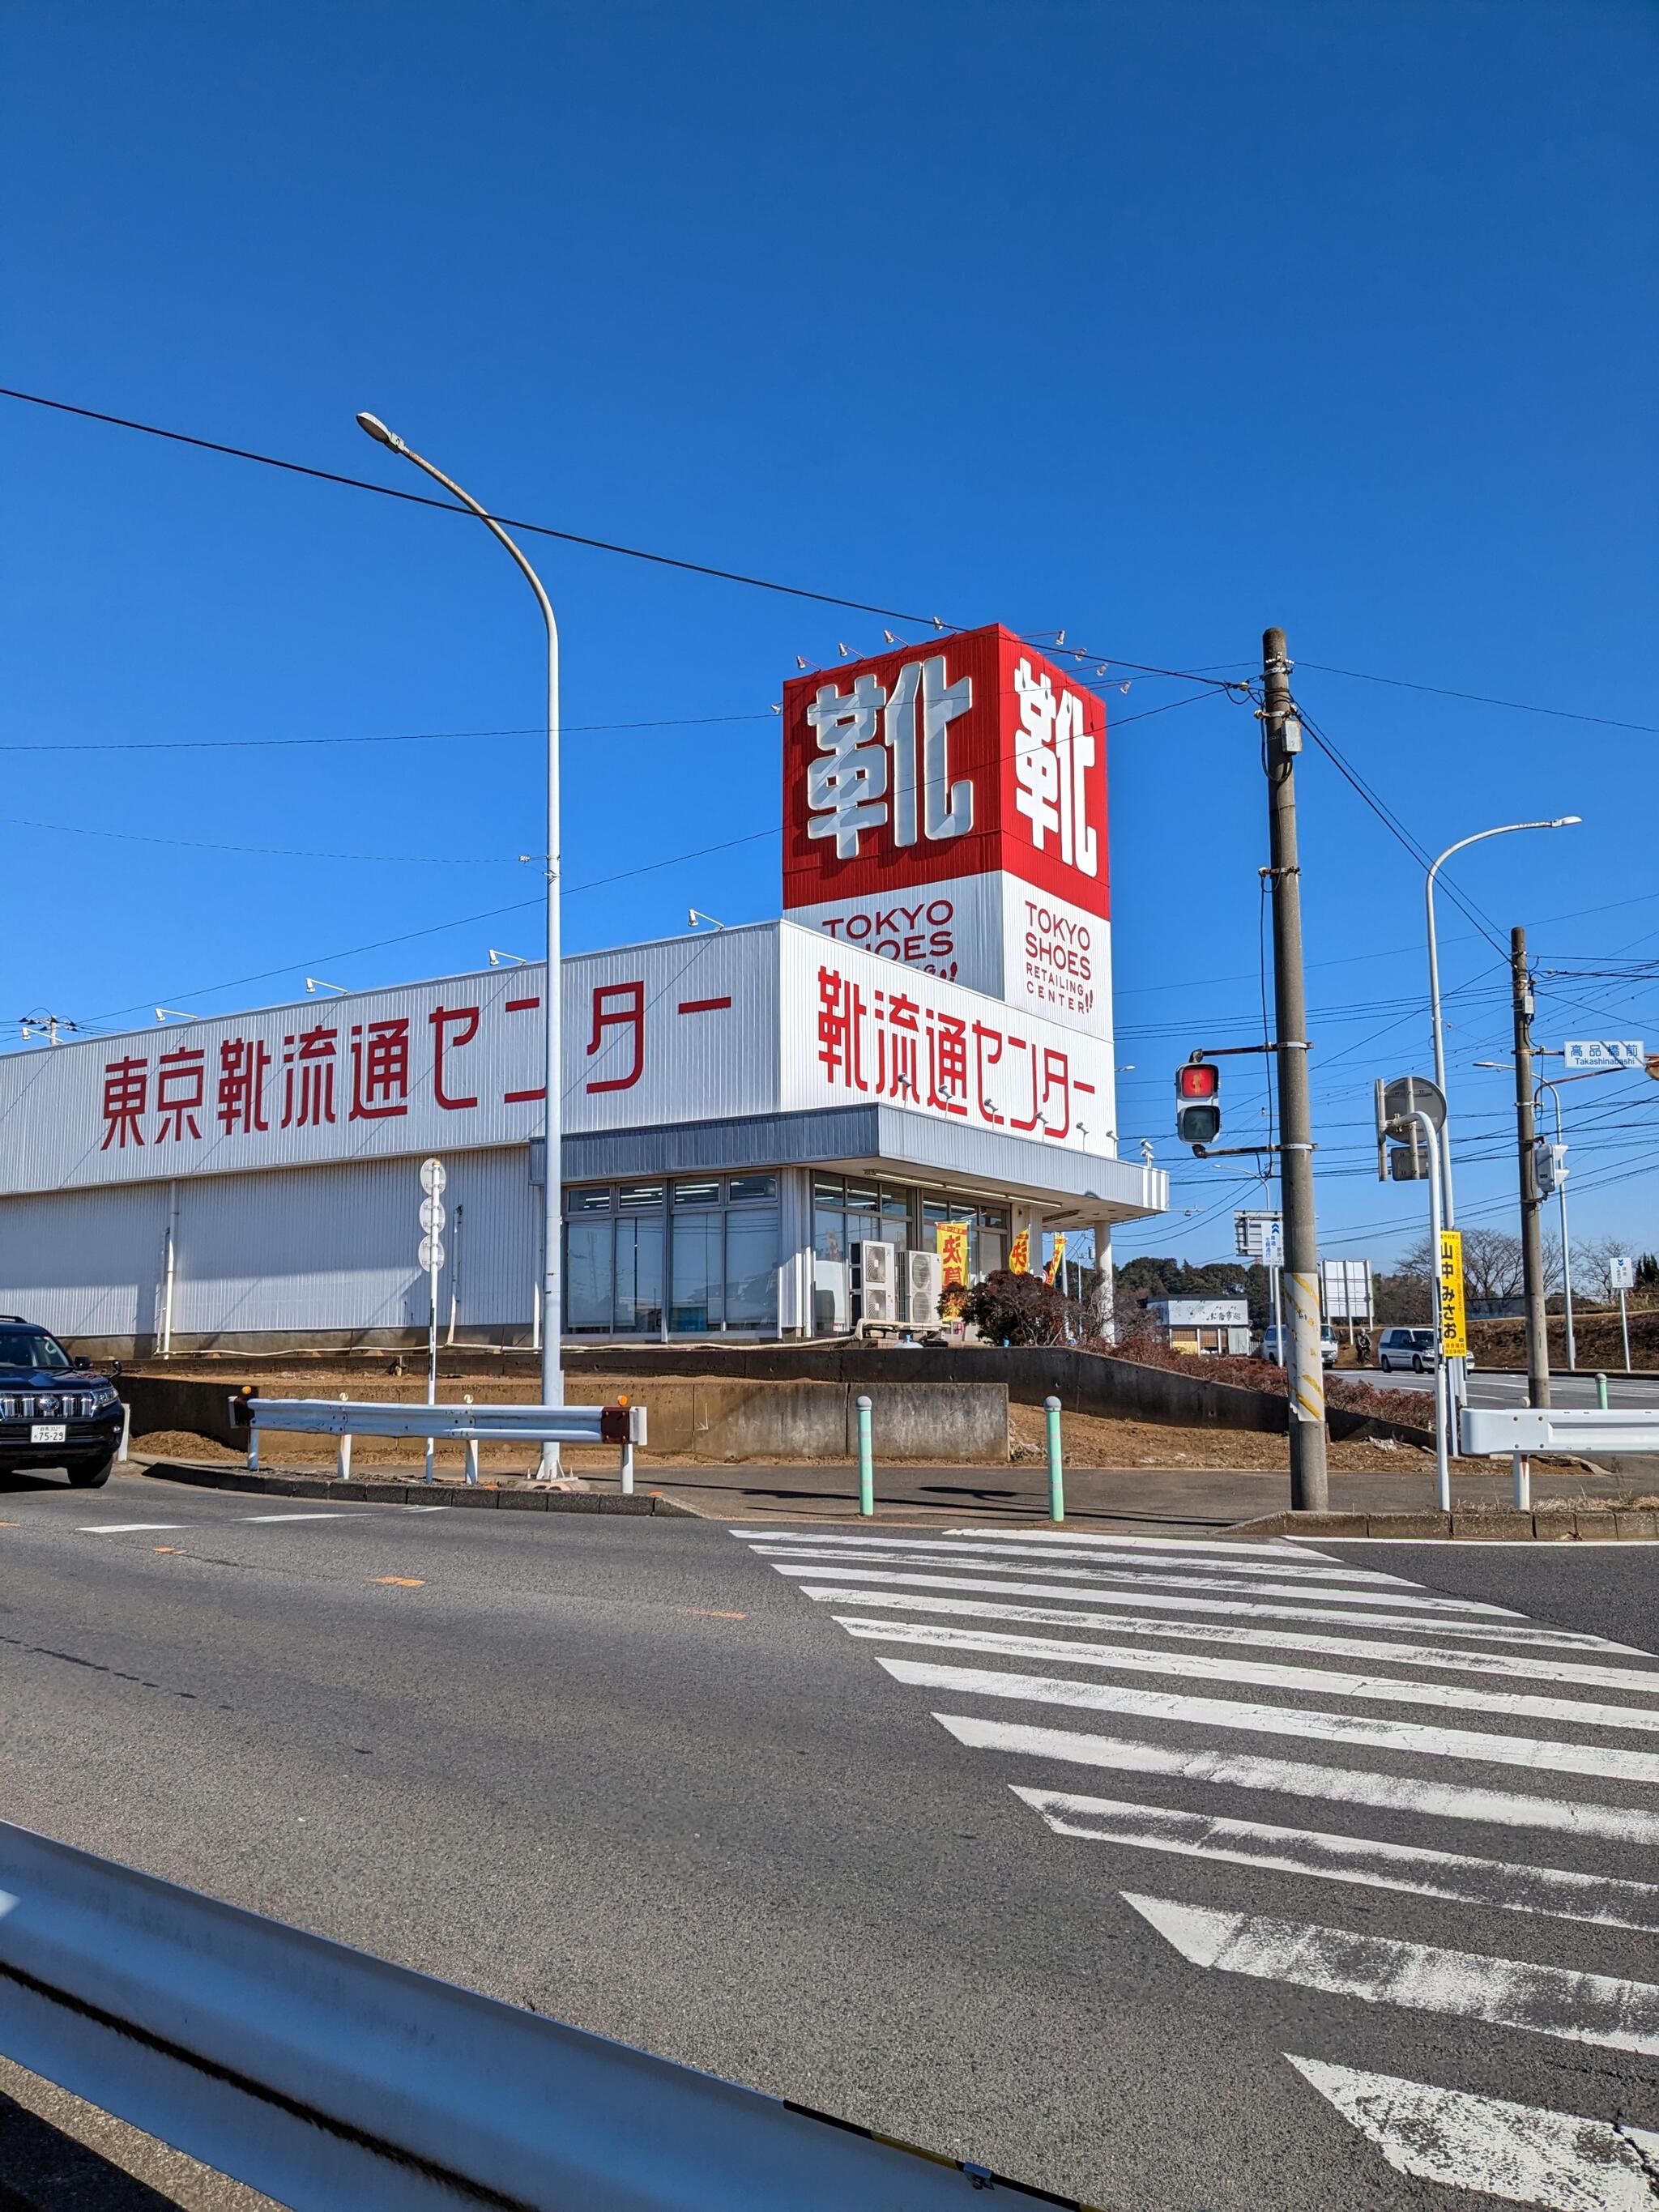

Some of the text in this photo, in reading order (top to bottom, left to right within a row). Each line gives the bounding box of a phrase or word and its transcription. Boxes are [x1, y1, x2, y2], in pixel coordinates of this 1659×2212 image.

[807, 654, 974, 860] 靴
[1013, 657, 1098, 878] 靴
[822, 900, 954, 940] TOKYO
[1025, 900, 1090, 952] TOKYO
[1025, 931, 1092, 981] SHOES
[1026, 961, 1085, 996] RETAILING
[1026, 980, 1085, 1015] CENTER
[818, 965, 1095, 1140] 靴流通センター
[1570, 1044, 1637, 1056] 高品橋前
[1441, 1242, 1456, 1339] 山中みさお
[39, 1432, 63, 1441] 75-29
